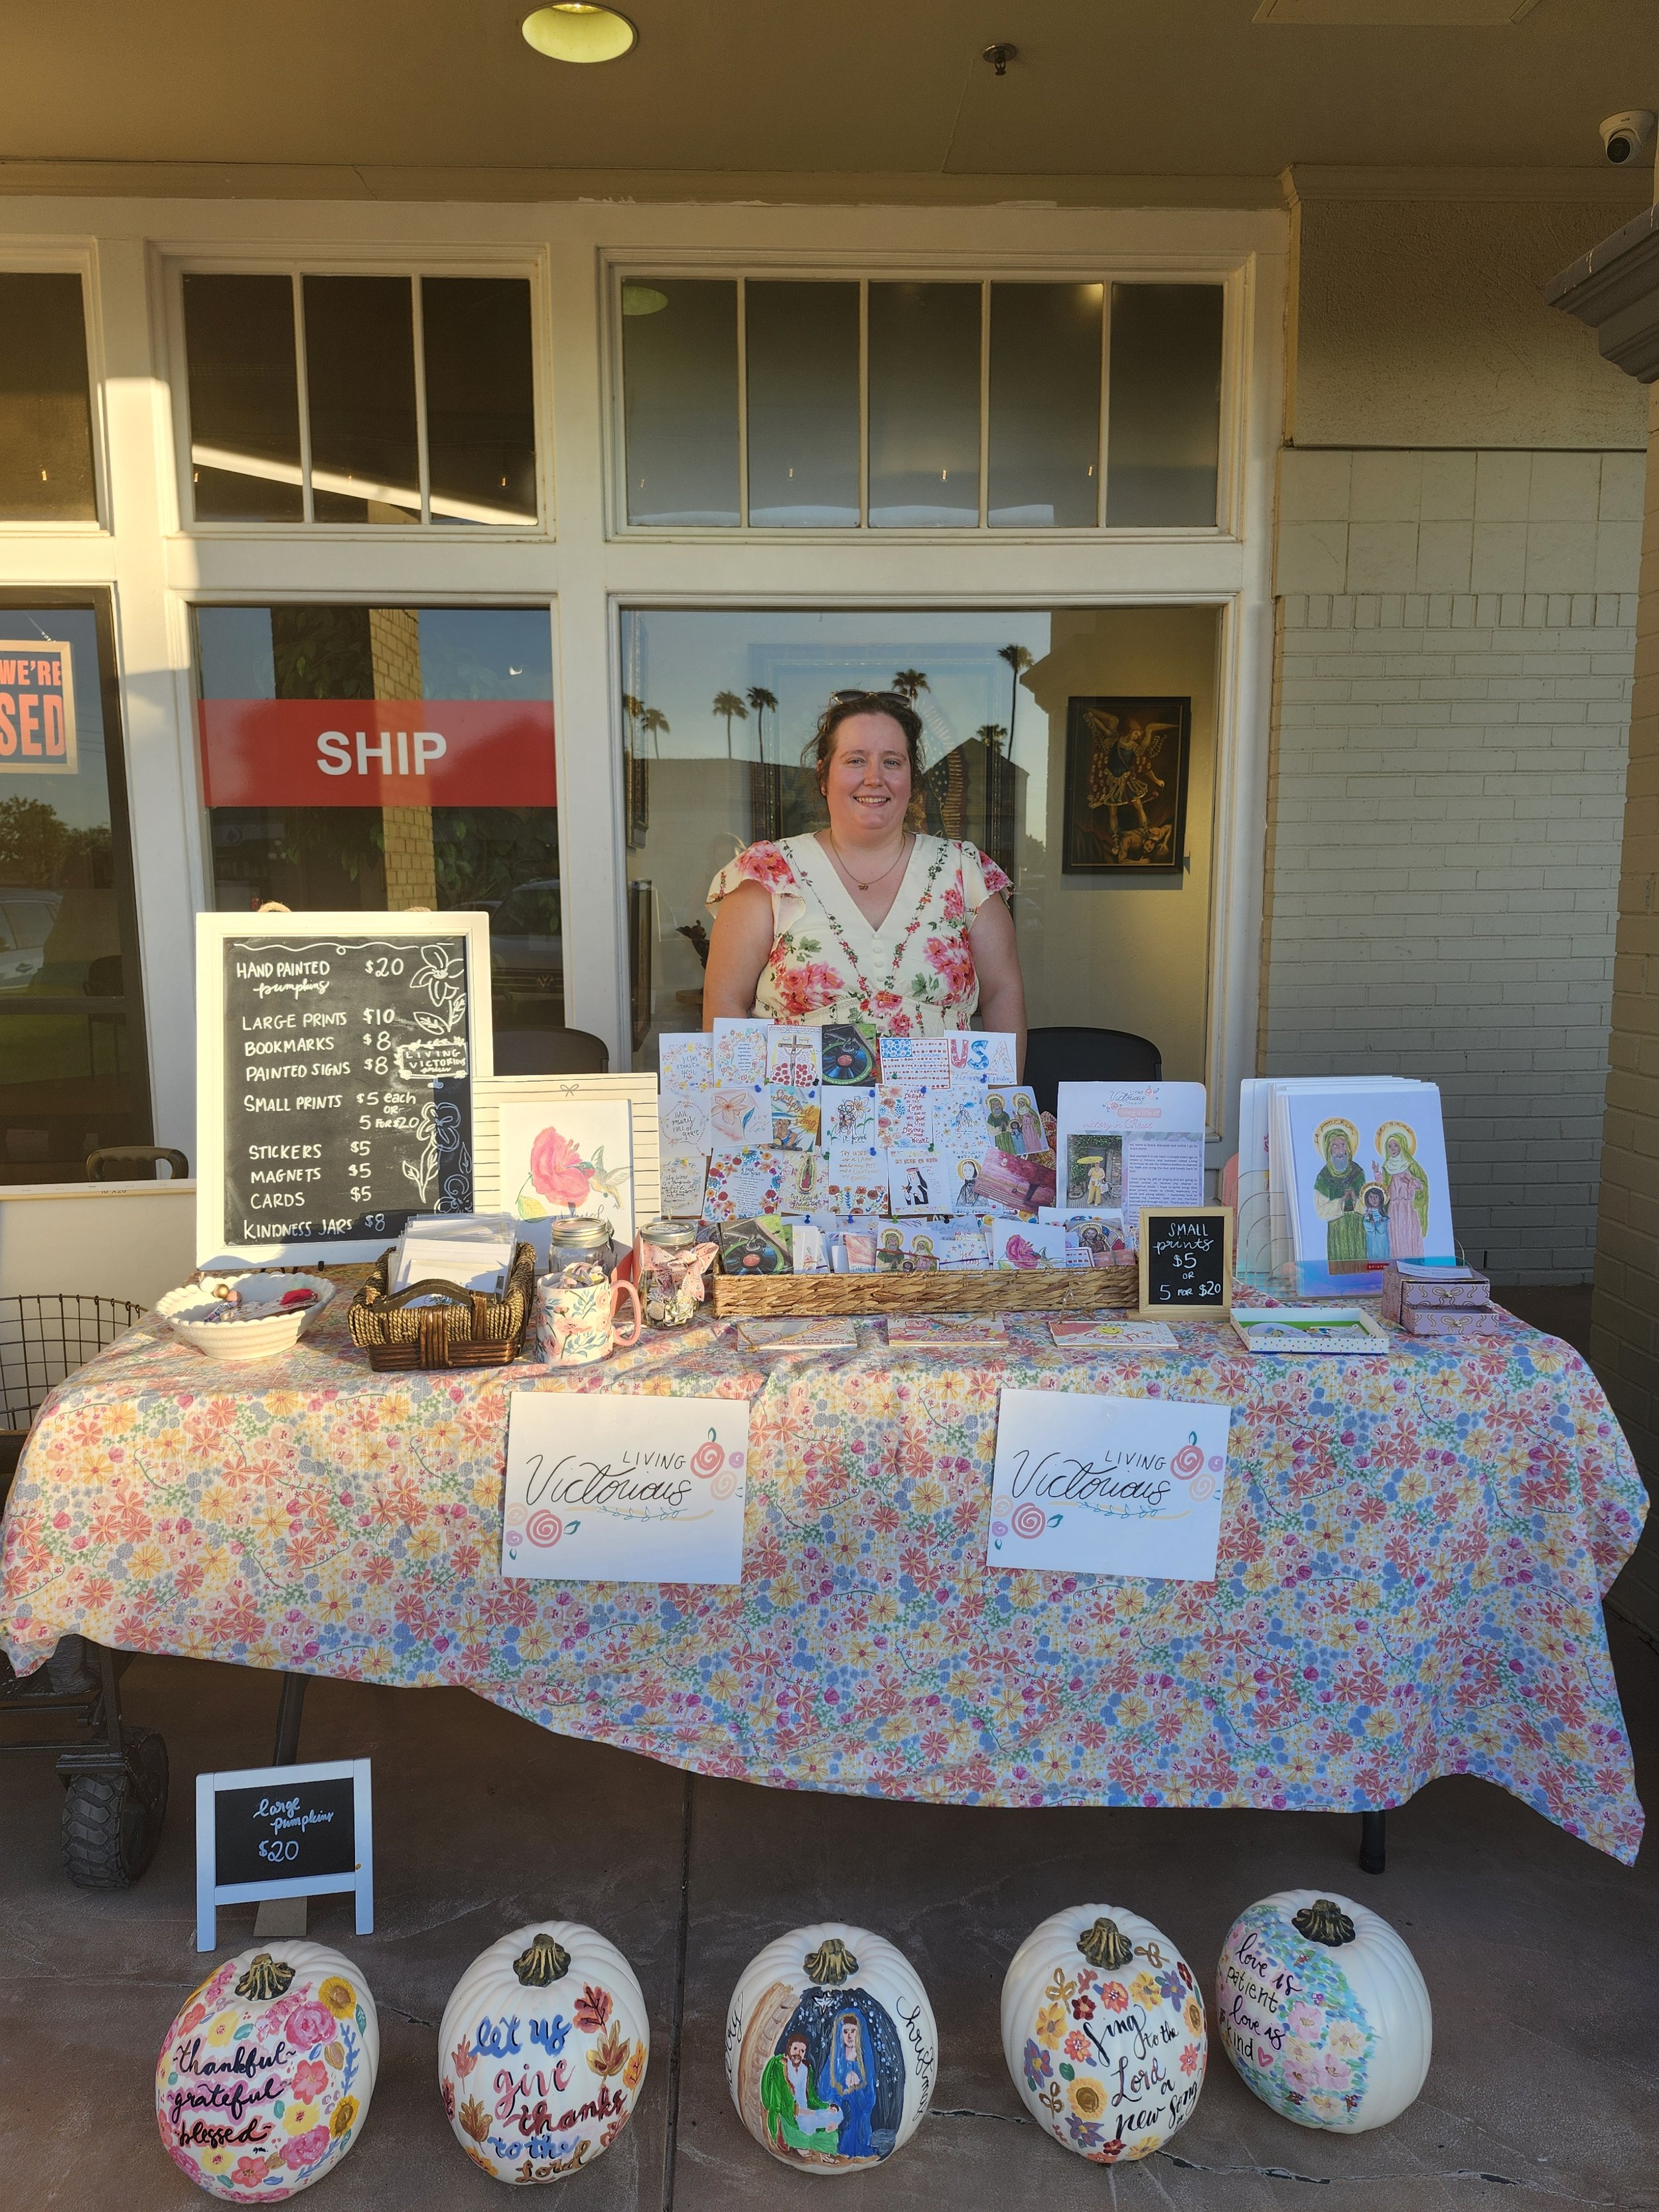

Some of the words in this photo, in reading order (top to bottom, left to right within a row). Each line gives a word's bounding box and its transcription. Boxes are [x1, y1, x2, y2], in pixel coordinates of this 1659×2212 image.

[0, 660, 62, 686] WE'RE
[317, 731, 447, 775] SHIP
[236, 962, 273, 978] HAND
[276, 960, 330, 977] PAINTED
[365, 958, 403, 977] $20
[242, 1015, 296, 1031] LARGE
[303, 1011, 346, 1028] PRINTS
[362, 1009, 394, 1025] $10
[245, 1037, 334, 1056] BOOKMARKS
[406, 1049, 461, 1059] LIVING
[950, 1039, 1015, 1073] USA
[246, 1066, 307, 1081] PAINTED
[313, 1062, 350, 1076] SIGNS
[364, 1057, 388, 1074] $8
[244, 1096, 291, 1112] SMALL
[297, 1095, 342, 1111] PRINTS
[357, 1093, 378, 1105] $5
[383, 1092, 416, 1104] each
[384, 1105, 401, 1114] OR
[360, 1116, 370, 1129] 5
[249, 1144, 322, 1160] STICKERS
[350, 1142, 370, 1155] $5
[251, 1168, 321, 1183] MAGNETS
[348, 1163, 371, 1178] $5
[251, 1193, 305, 1209] CARDS
[350, 1187, 371, 1202] $5
[244, 1219, 312, 1239] KINDNESS
[319, 1219, 352, 1235] JARS
[365, 1214, 385, 1232] $8
[1169, 1222, 1208, 1237] SMALL
[1152, 1236, 1214, 1255] prints
[1173, 1252, 1196, 1269] $5
[1160, 1285, 1171, 1300] 5
[1198, 1281, 1221, 1297] $20
[622, 1450, 687, 1470] LIVING
[1105, 1450, 1167, 1471] LIVING
[526, 1454, 692, 1507] Victorious
[1013, 1449, 1171, 1505] Victorious
[259, 1840, 299, 1862] $20
[1235, 1933, 1268, 1978] love
[1273, 1967, 1303, 1994] is
[1226, 1966, 1277, 2014] patient
[1160, 2020, 1179, 2044] the
[1230, 1995, 1262, 2036] love
[1264, 2023, 1285, 2050] is
[468, 2014, 521, 2059] let
[529, 2014, 573, 2057] us
[177, 2037, 291, 2079] thankful
[897, 1996, 934, 2122] Christmas
[493, 2058, 577, 2120] give
[1111, 2056, 1165, 2107] Lord
[1161, 2079, 1175, 2095] a
[172, 2079, 285, 2124] grateful
[503, 2085, 628, 2136] thanks
[179, 2118, 267, 2148] blessed
[487, 2135, 524, 2160] to
[524, 2132, 581, 2160] the
